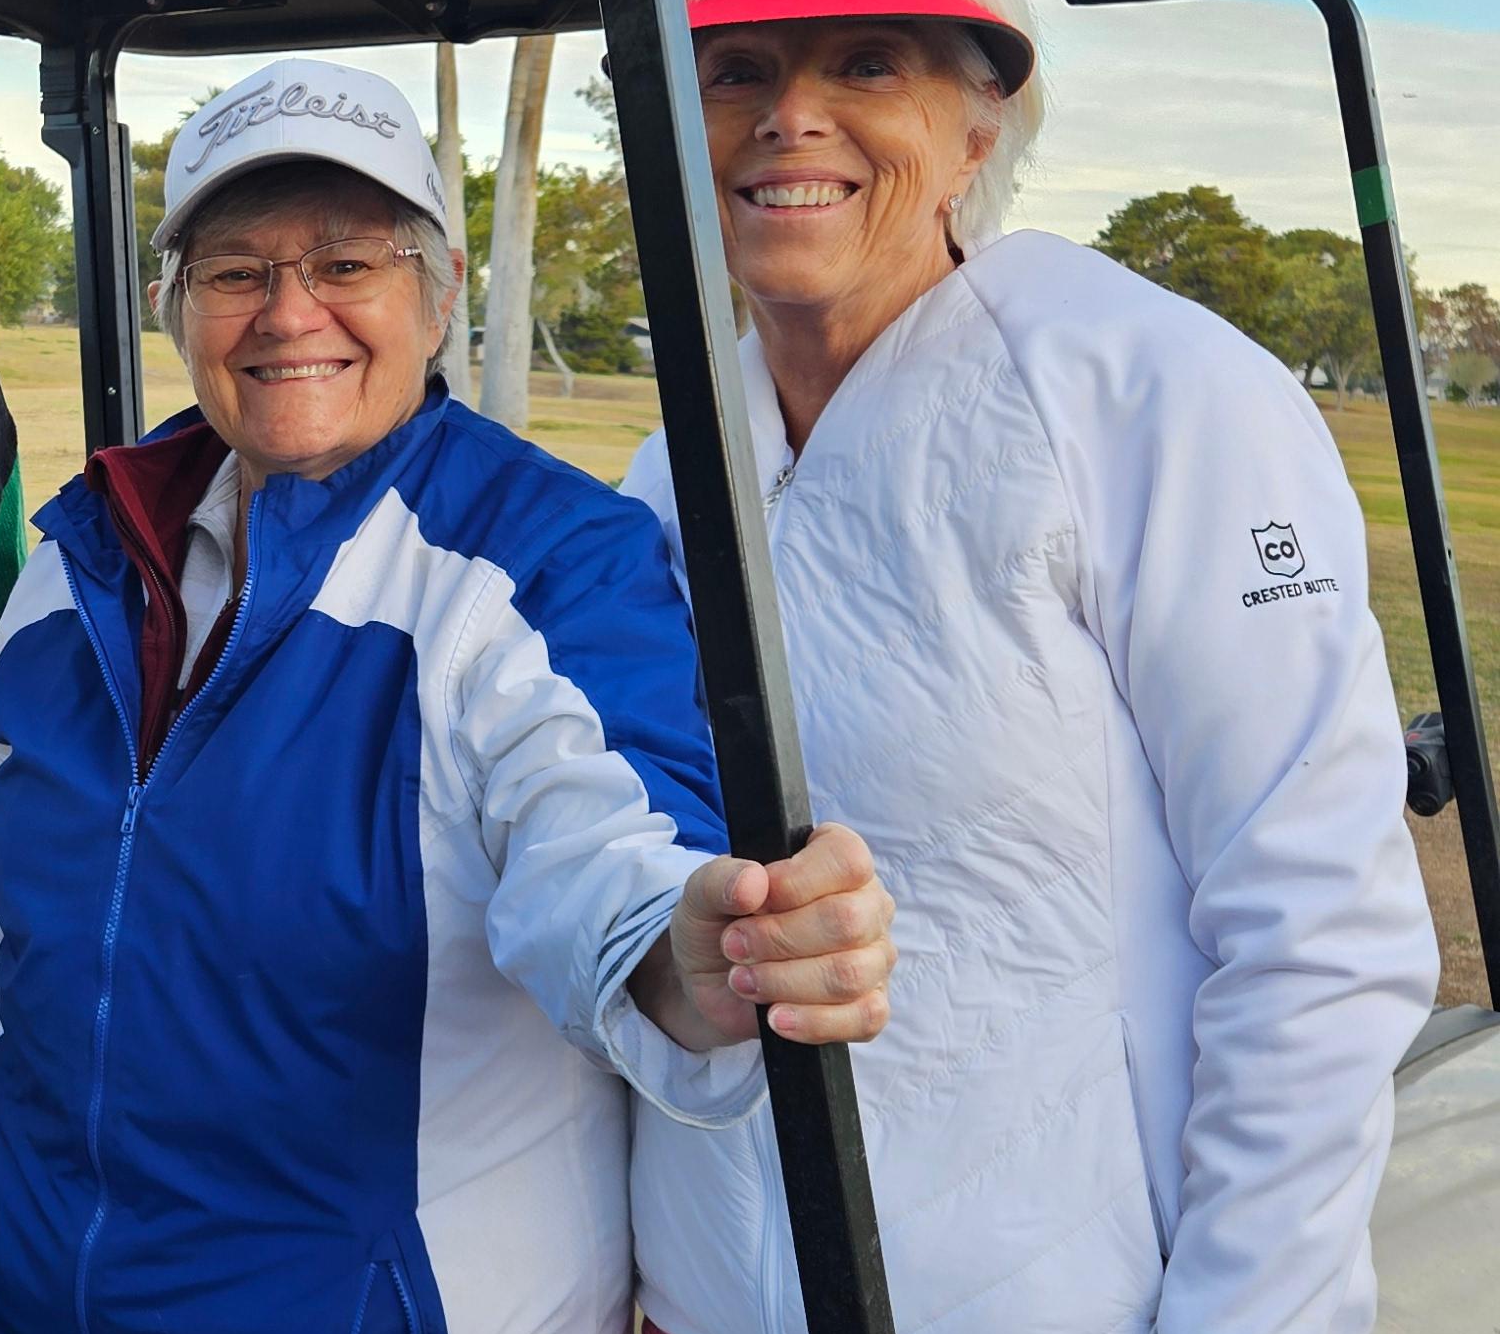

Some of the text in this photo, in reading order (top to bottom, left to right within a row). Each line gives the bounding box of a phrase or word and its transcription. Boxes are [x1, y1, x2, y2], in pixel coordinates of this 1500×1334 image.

[185, 80, 402, 173] Titleist
[1264, 540, 1296, 561] CO
[1242, 578, 1340, 608] CRESTED BUTTE
